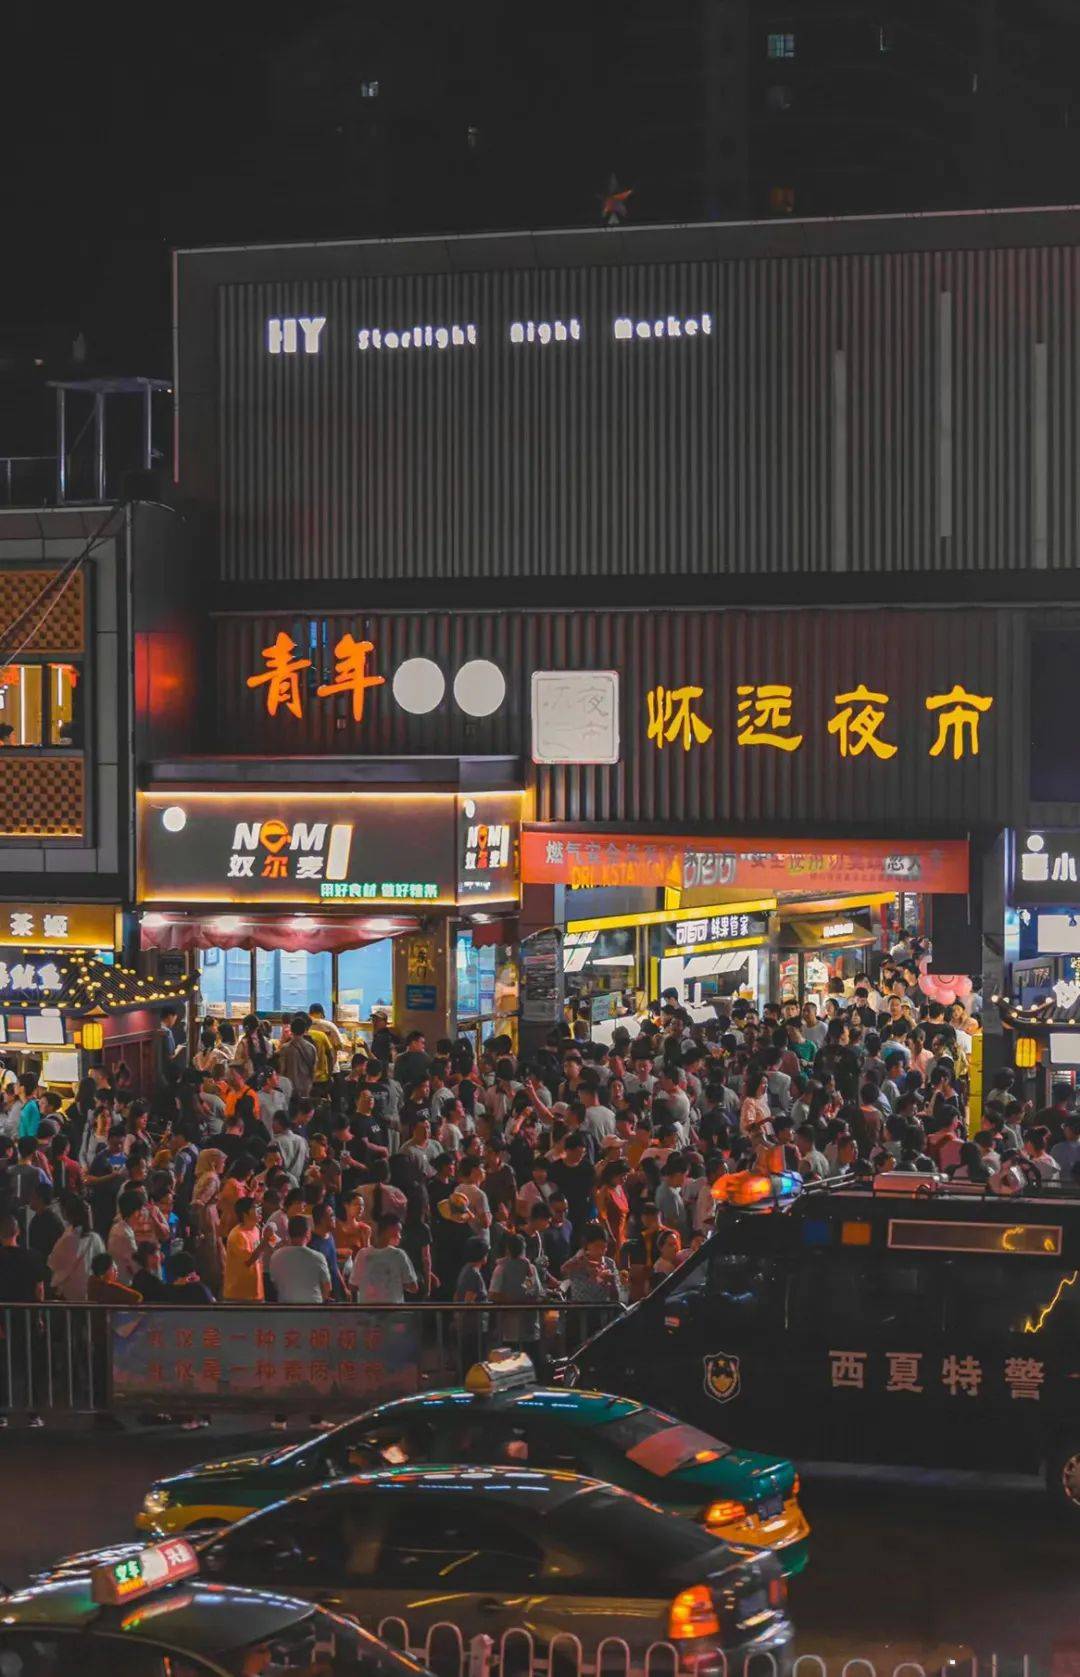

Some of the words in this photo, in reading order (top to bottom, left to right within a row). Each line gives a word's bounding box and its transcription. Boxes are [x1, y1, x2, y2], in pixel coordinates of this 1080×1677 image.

[614, 313, 711, 339] Market
[246, 631, 385, 722] 青年
[646, 684, 994, 760] 怀远夜市
[227, 854, 324, 879] 奴尔麦
[828, 1350, 1046, 1400] 西夏特警
